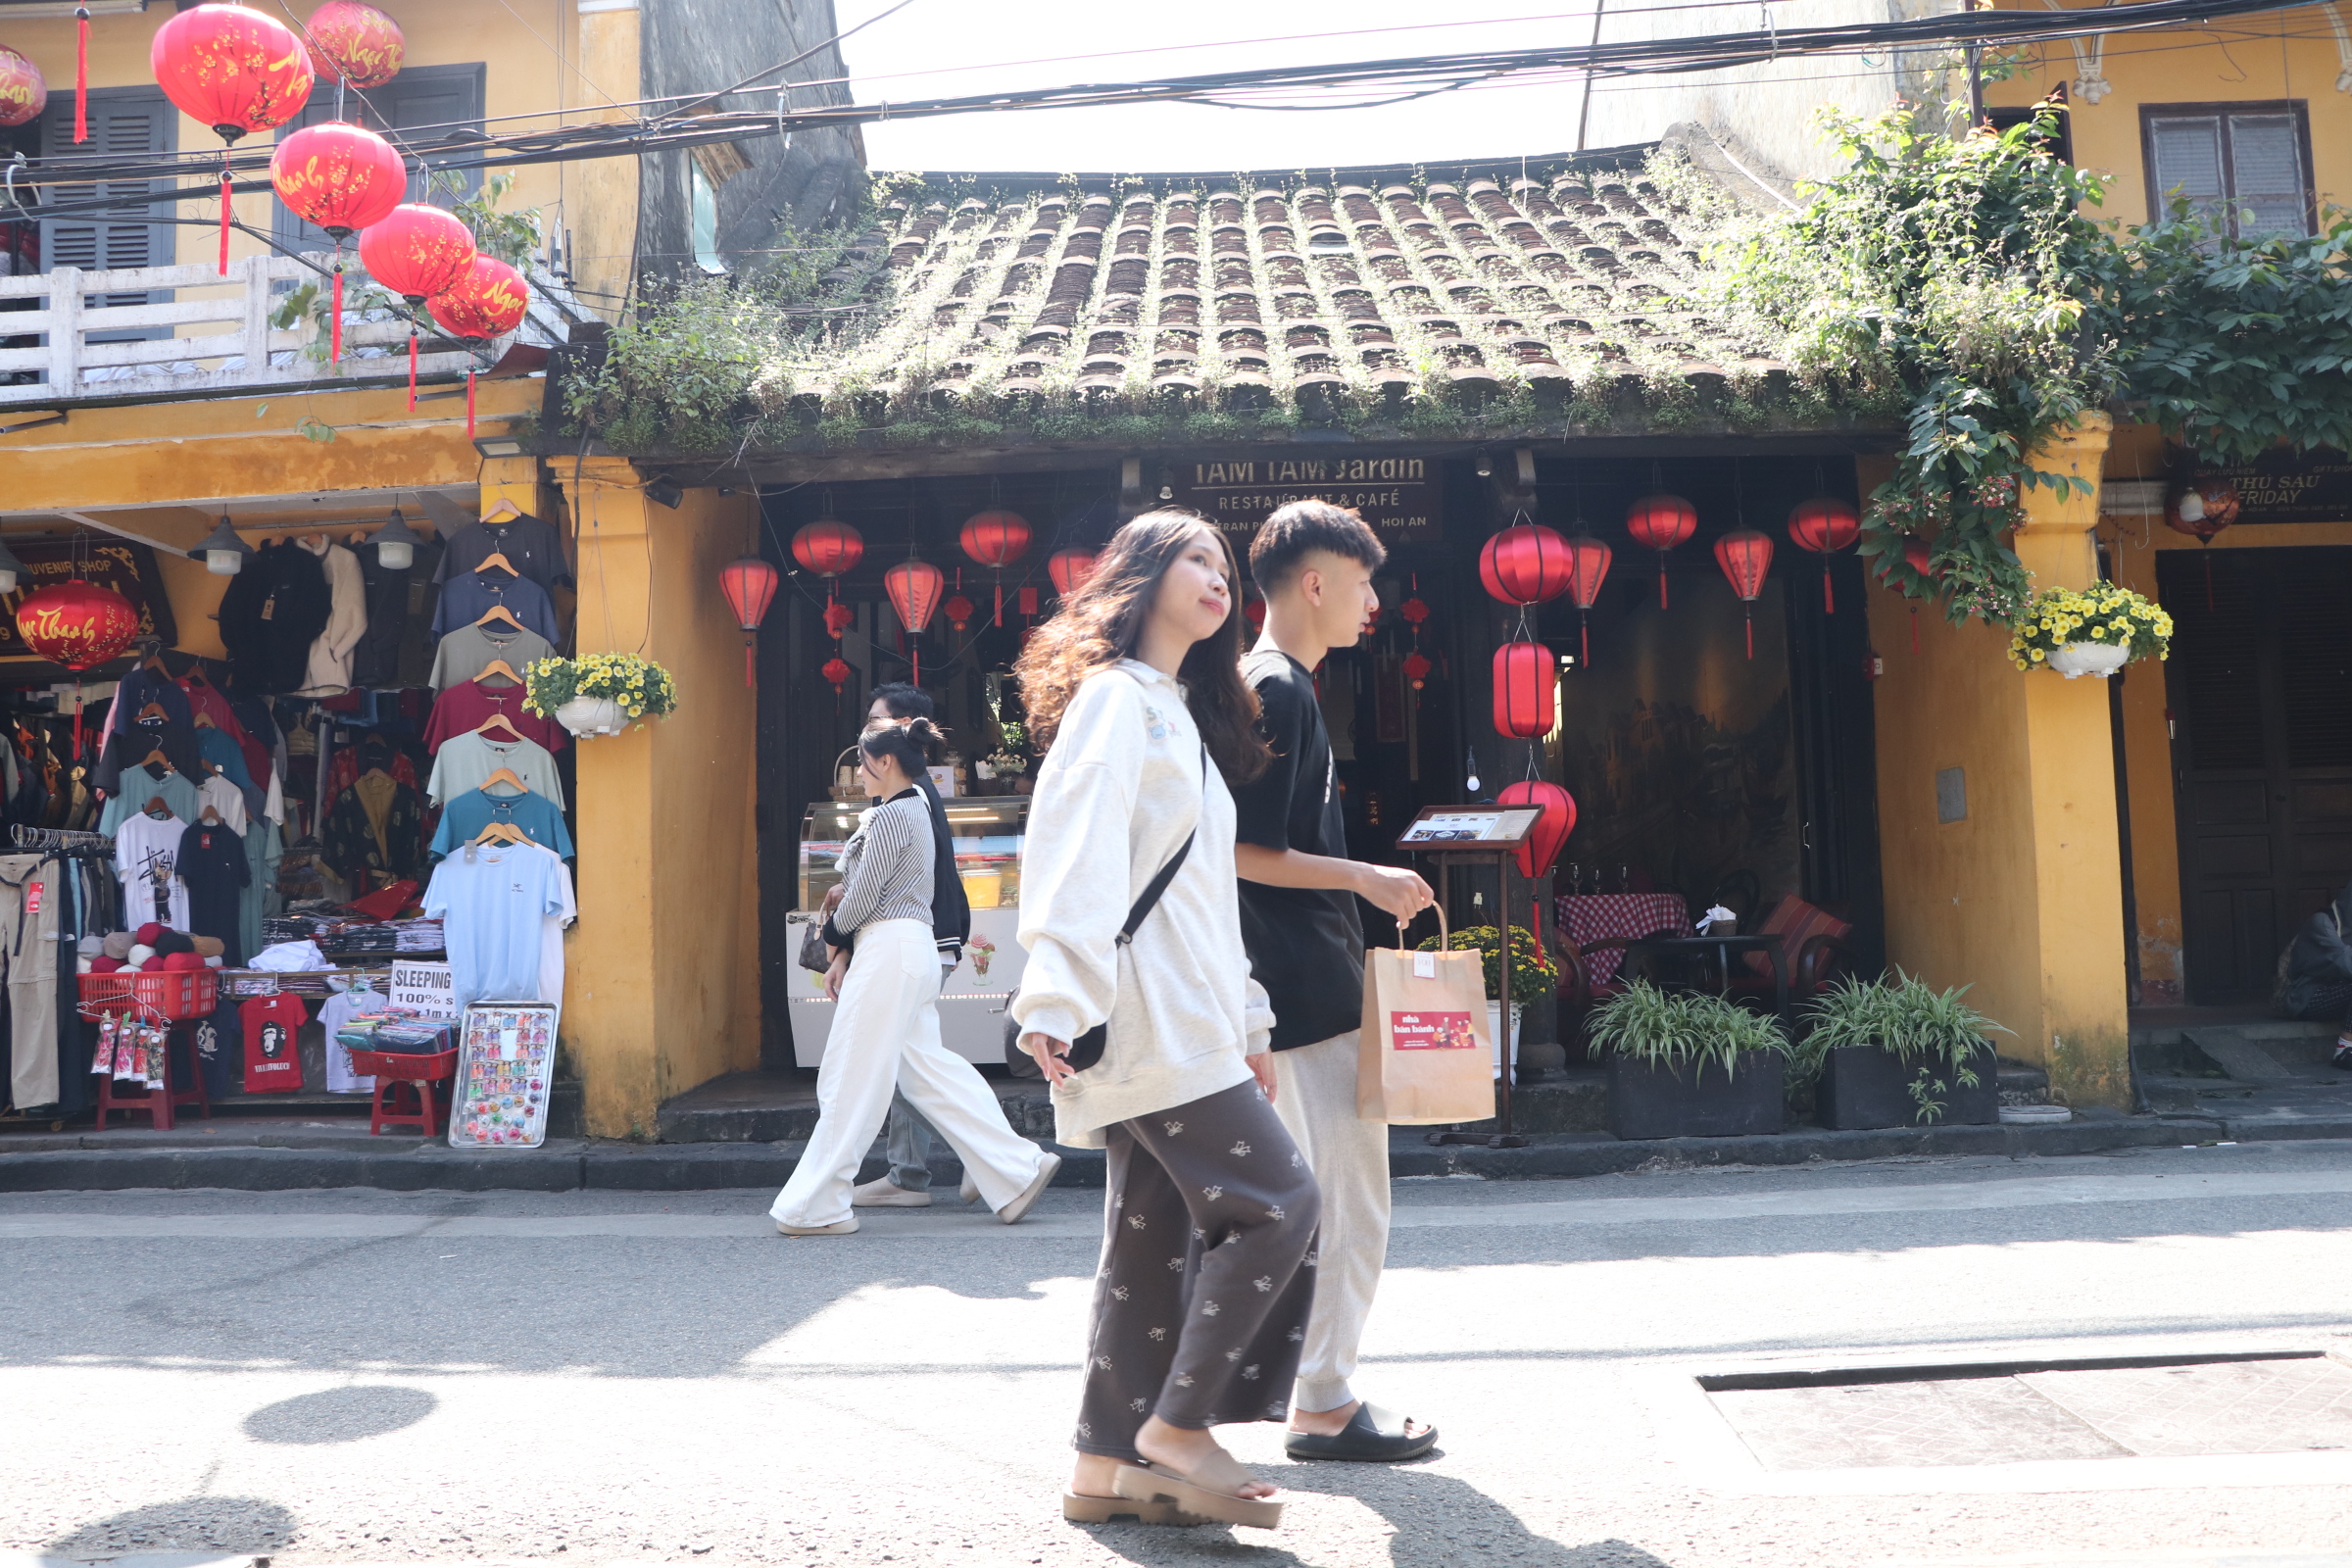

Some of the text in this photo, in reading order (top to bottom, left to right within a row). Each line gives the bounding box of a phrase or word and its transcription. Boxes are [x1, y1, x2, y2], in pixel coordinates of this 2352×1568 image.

[1339, 493, 1350, 507] &
[1355, 488, 1399, 507] CAFÉ
[1381, 517, 1404, 527] HOI
[1408, 516, 1426, 526] AN
[24, 560, 112, 575] UVENIR SHOP
[395, 969, 452, 990] SLEEPING
[396, 993, 441, 1004] 100%
